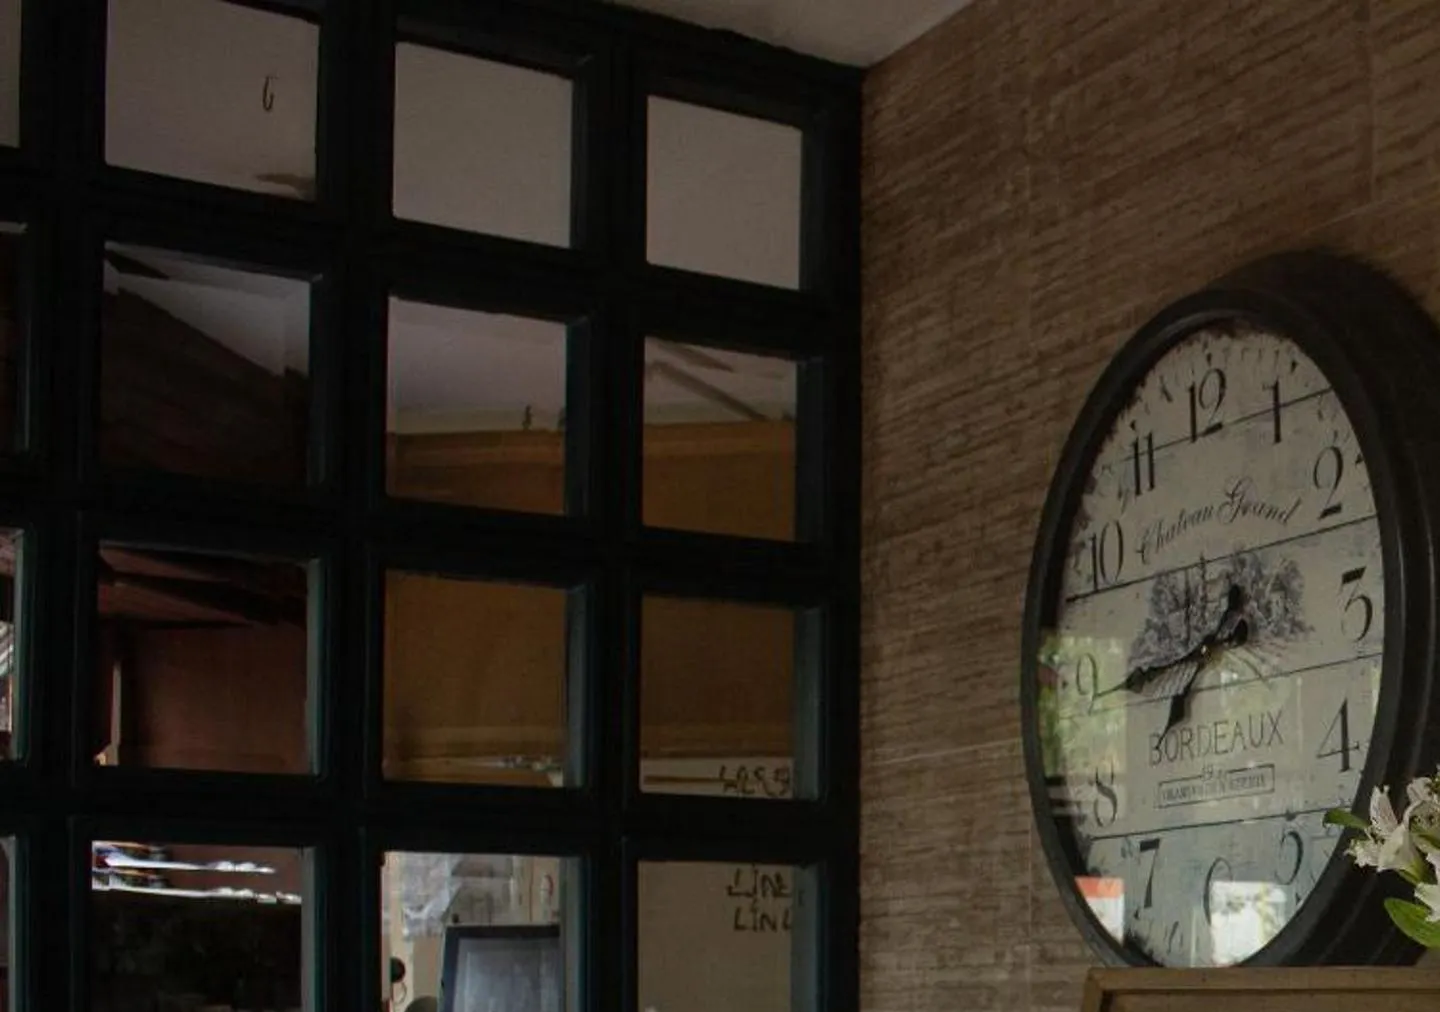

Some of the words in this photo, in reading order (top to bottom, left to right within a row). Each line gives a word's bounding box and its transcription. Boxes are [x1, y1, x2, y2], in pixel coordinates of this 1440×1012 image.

[1189, 367, 1227, 443] 12
[1263, 378, 1282, 443] 1
[1132, 431, 1155, 496] 11
[1313, 445, 1344, 520] 2
[1090, 519, 1124, 590] 10
[1340, 566, 1373, 642] 3
[1075, 652, 1099, 716] 9
[1149, 708, 1285, 767] BORDEAUX
[1316, 698, 1360, 772] 4
[1092, 763, 1119, 828] 8
[1138, 837, 1161, 909] 7
